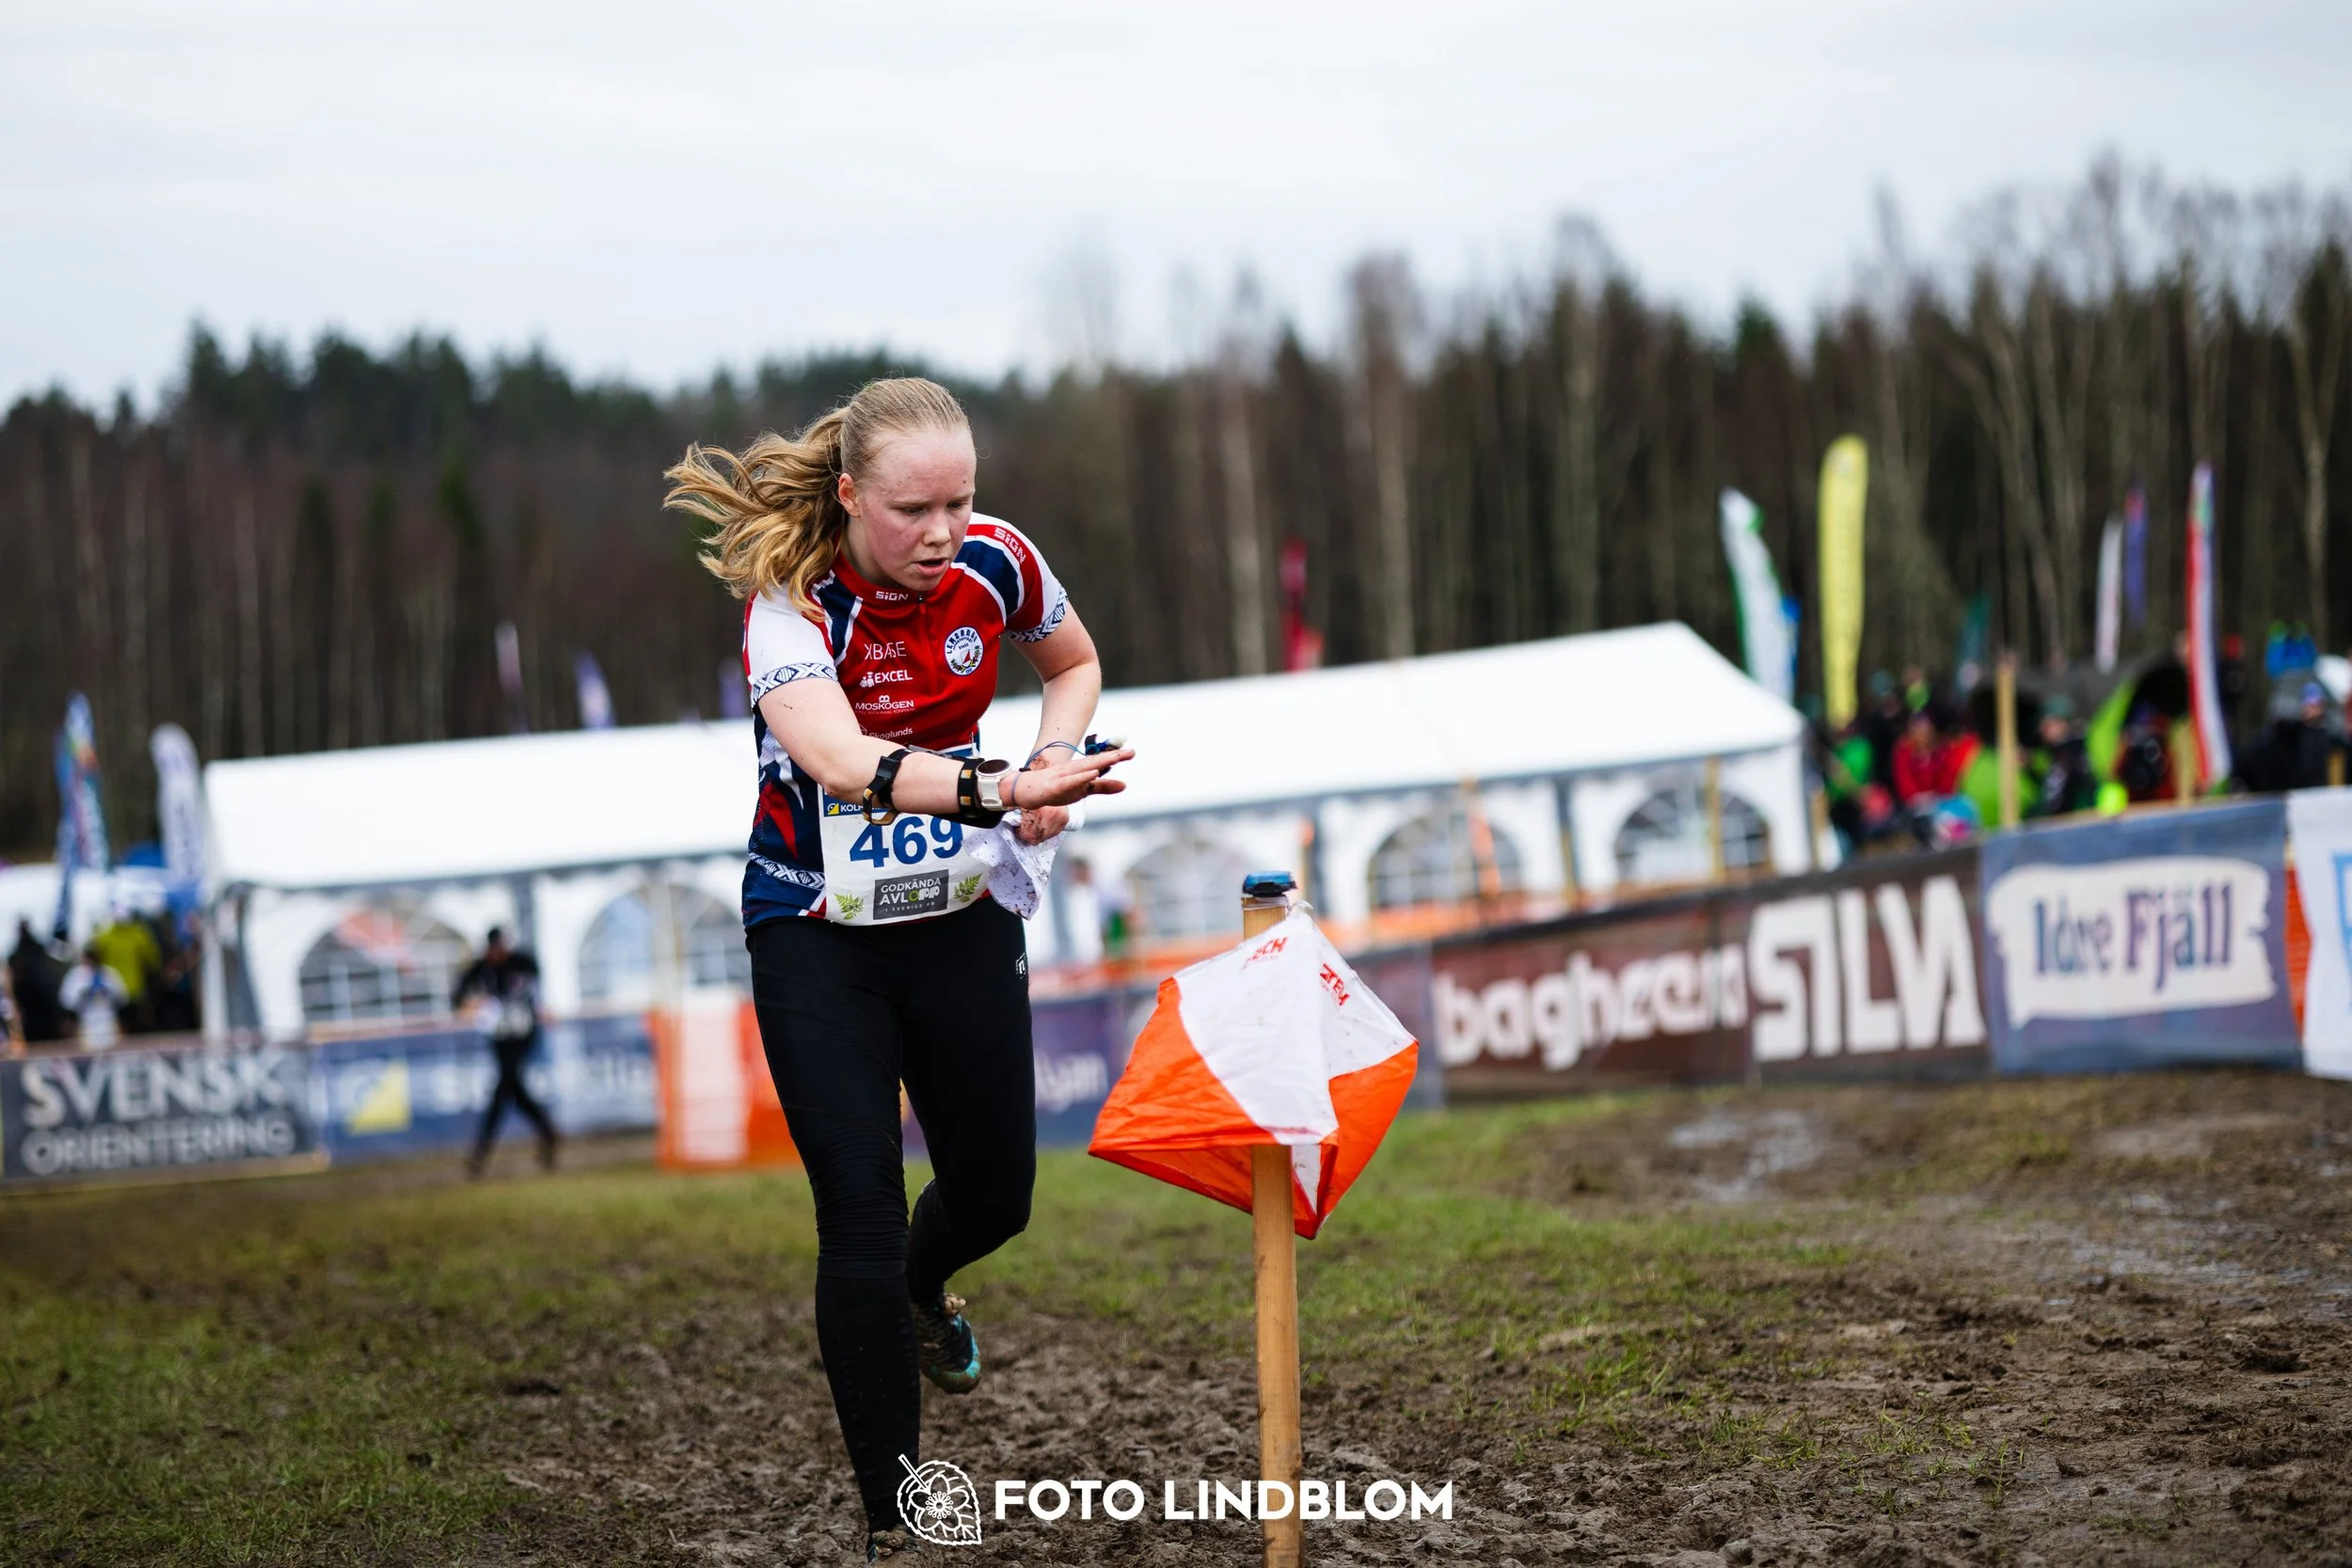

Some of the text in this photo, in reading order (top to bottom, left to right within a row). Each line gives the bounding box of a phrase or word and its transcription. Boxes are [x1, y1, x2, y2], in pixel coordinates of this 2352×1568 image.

[855, 700, 914, 711] MOSKOGEN
[874, 670, 914, 684] EXCEL
[850, 816, 963, 868] 469
[881, 878, 942, 894] GODKÄNDA
[2032, 895, 2113, 976] Idre
[2125, 880, 2233, 994] Fjäll
[1751, 875, 1987, 1061] SILVA
[21, 1048, 294, 1129] SVENSK
[21, 1112, 296, 1176] ORIENTERING
